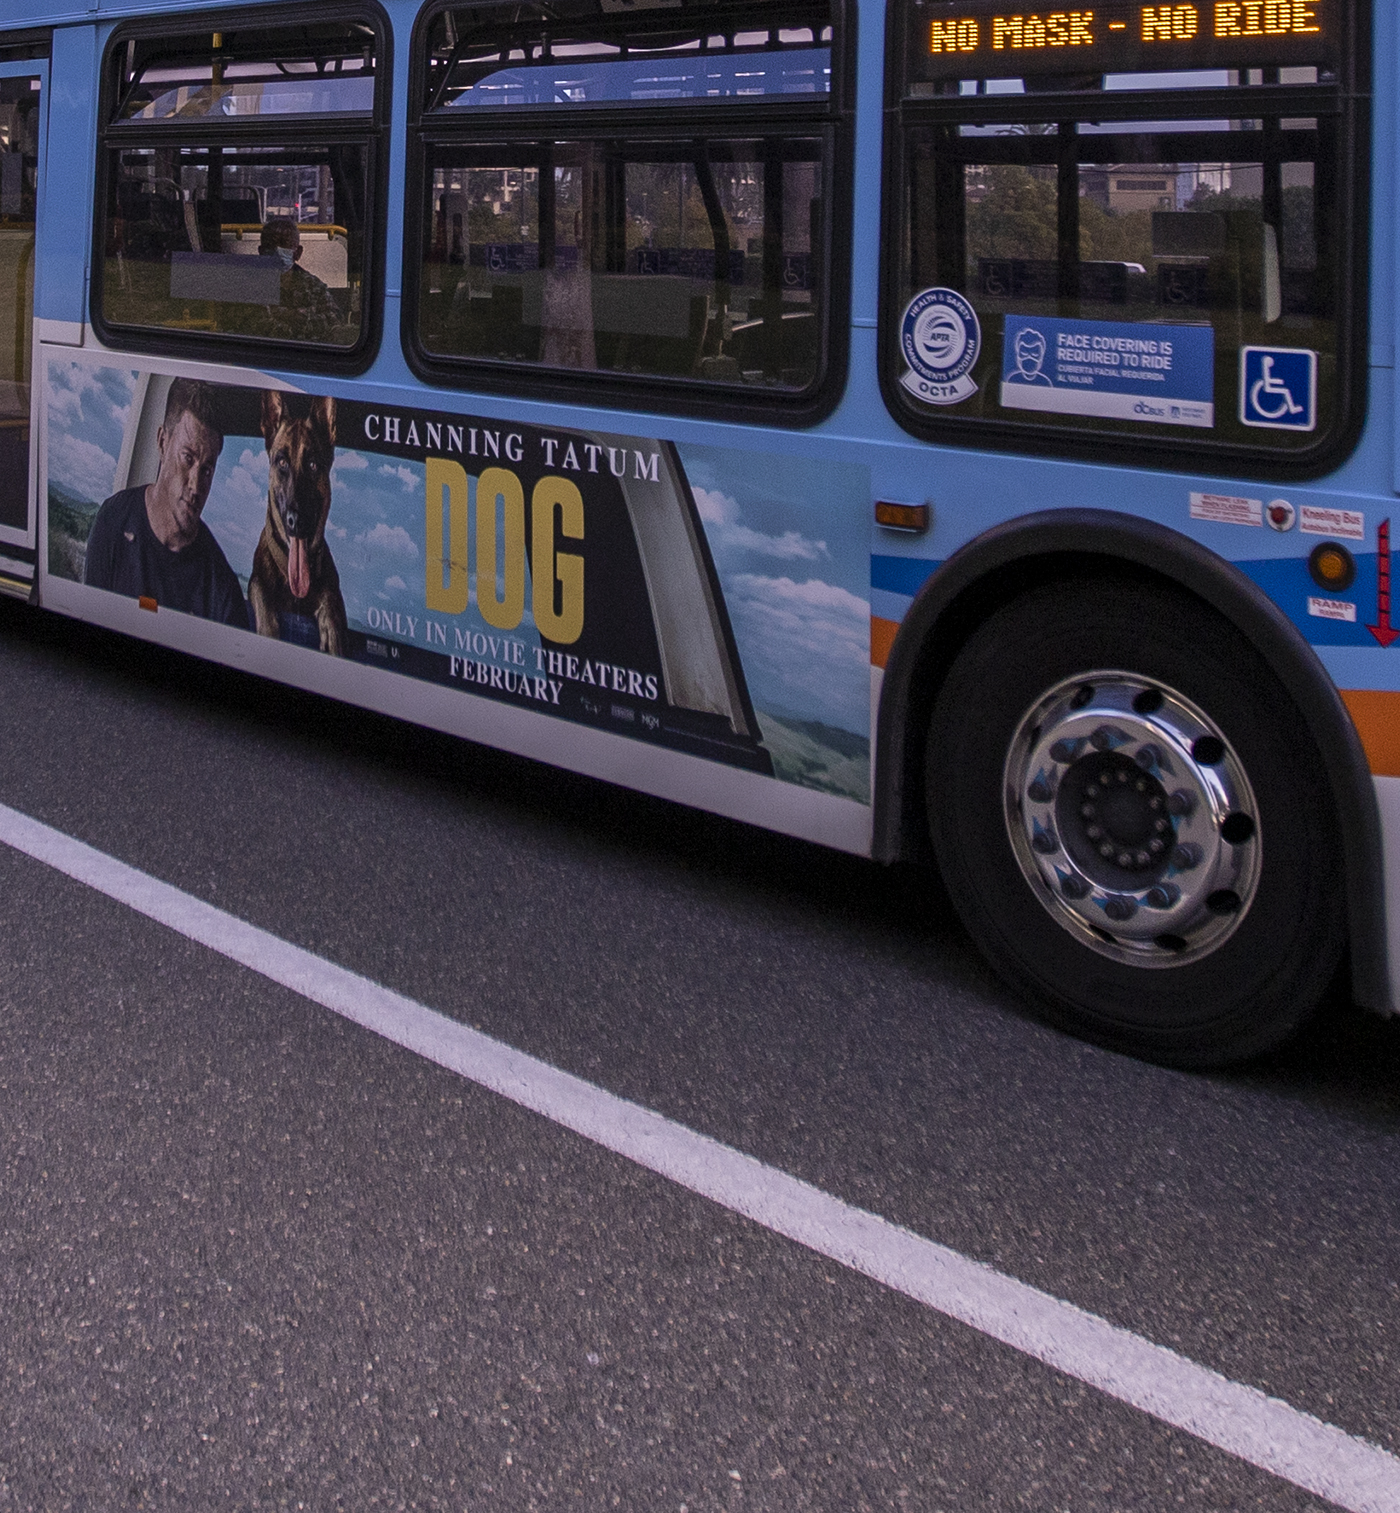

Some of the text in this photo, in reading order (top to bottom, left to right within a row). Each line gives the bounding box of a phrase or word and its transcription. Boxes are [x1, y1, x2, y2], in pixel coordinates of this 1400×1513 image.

[931, 19, 978, 53] NO
[993, 12, 1093, 49] MASK
[1141, 4, 1198, 42] NO
[909, 293, 937, 317] HEALTH
[946, 295, 972, 320] SAFETY
[930, 333, 950, 342] APTA
[1057, 333, 1173, 355] FACE COVERING IS
[905, 333, 976, 381] COMMITMENTS PROGRAM
[1057, 348, 1173, 370] REQUIRED TO RIDE
[1058, 364, 1094, 374] CUBIERTA
[919, 382, 959, 396] OCTA
[364, 414, 661, 483] CHANNING TATUM
[1302, 507, 1361, 525] Kneeling Bus
[425, 456, 584, 645] DOG
[1312, 598, 1353, 611] RAMP
[367, 606, 659, 701] ONLY IN MOVIE THEATERS
[449, 655, 564, 706] FEBRUARY
